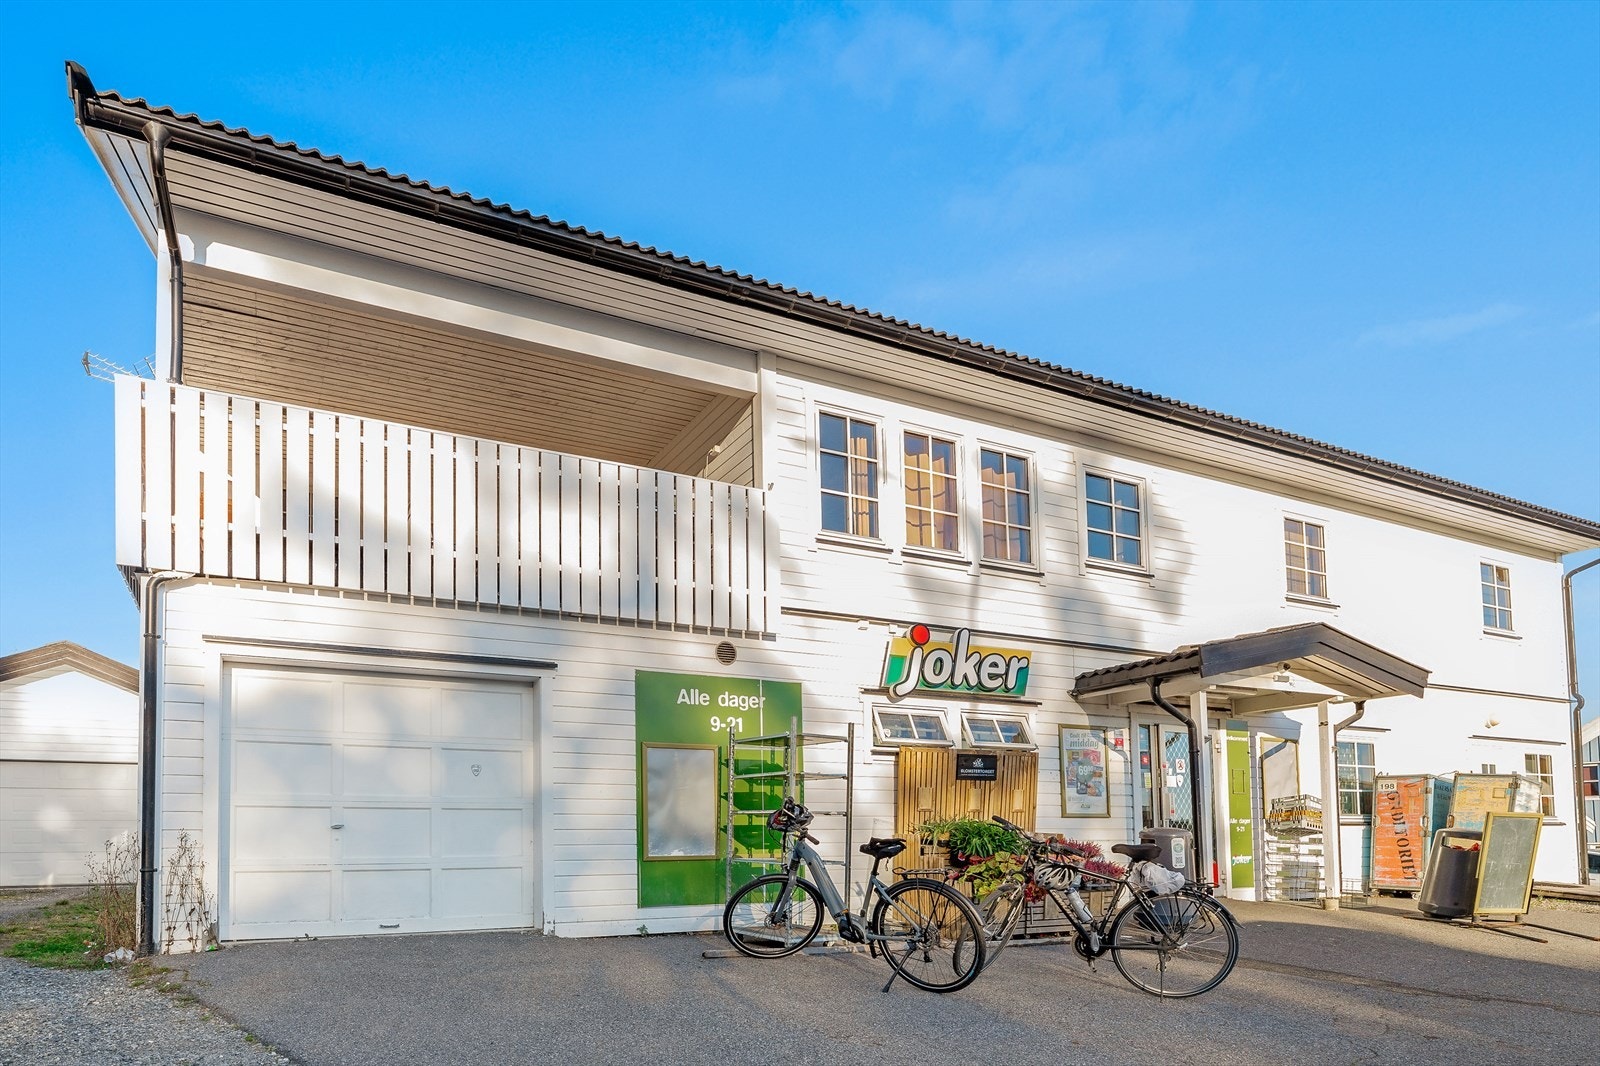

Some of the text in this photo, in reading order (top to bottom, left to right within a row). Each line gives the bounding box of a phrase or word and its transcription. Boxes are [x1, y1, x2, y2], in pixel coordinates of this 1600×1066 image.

[890, 623, 1030, 698] joker
[676, 688, 766, 711] Alle dager
[710, 716, 743, 733] 9-21
